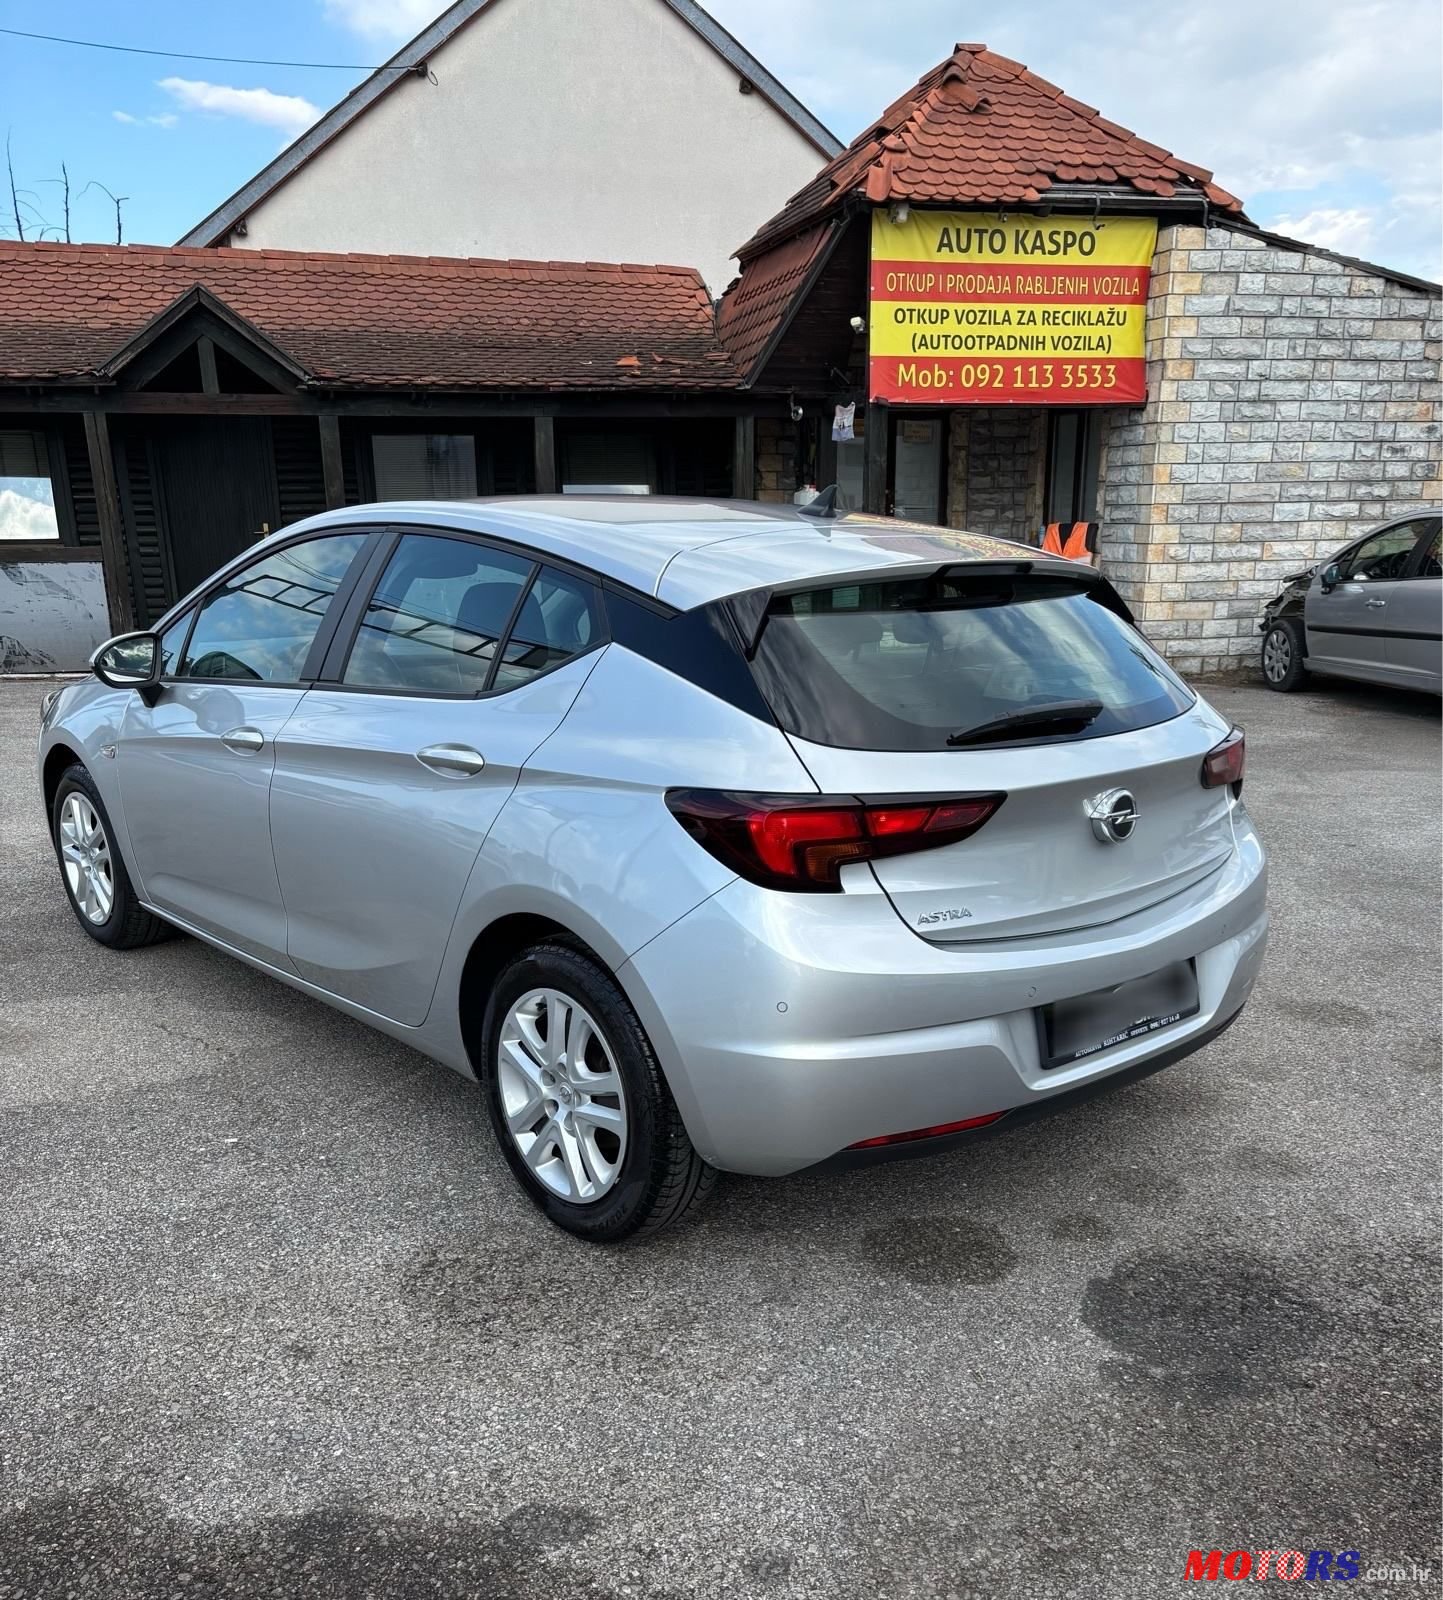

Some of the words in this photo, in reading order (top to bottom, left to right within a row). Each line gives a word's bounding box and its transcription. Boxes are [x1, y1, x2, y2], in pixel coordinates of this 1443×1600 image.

[936, 227, 1007, 255] AUTO
[1014, 229, 1096, 257] KASPO
[886, 272, 935, 293] OTKUP
[939, 274, 943, 293] I
[946, 273, 1011, 295] PRODAJA
[1016, 275, 1089, 296] RABLJENIH
[1091, 277, 1140, 296] VOZILA
[894, 308, 950, 325] OTKUP
[954, 309, 1012, 326] VOZILA
[1017, 310, 1038, 326] ZA
[1042, 307, 1127, 327] RECIKLAŽU
[912, 332, 1046, 353] (AUTOOTPADNIH
[1050, 334, 1112, 354] VOZILA)
[897, 363, 954, 388] Mob:
[961, 364, 1004, 388] 092
[1014, 364, 1054, 388] 113
[1061, 364, 1117, 388] 3533
[917, 906, 973, 925] ASTRA
